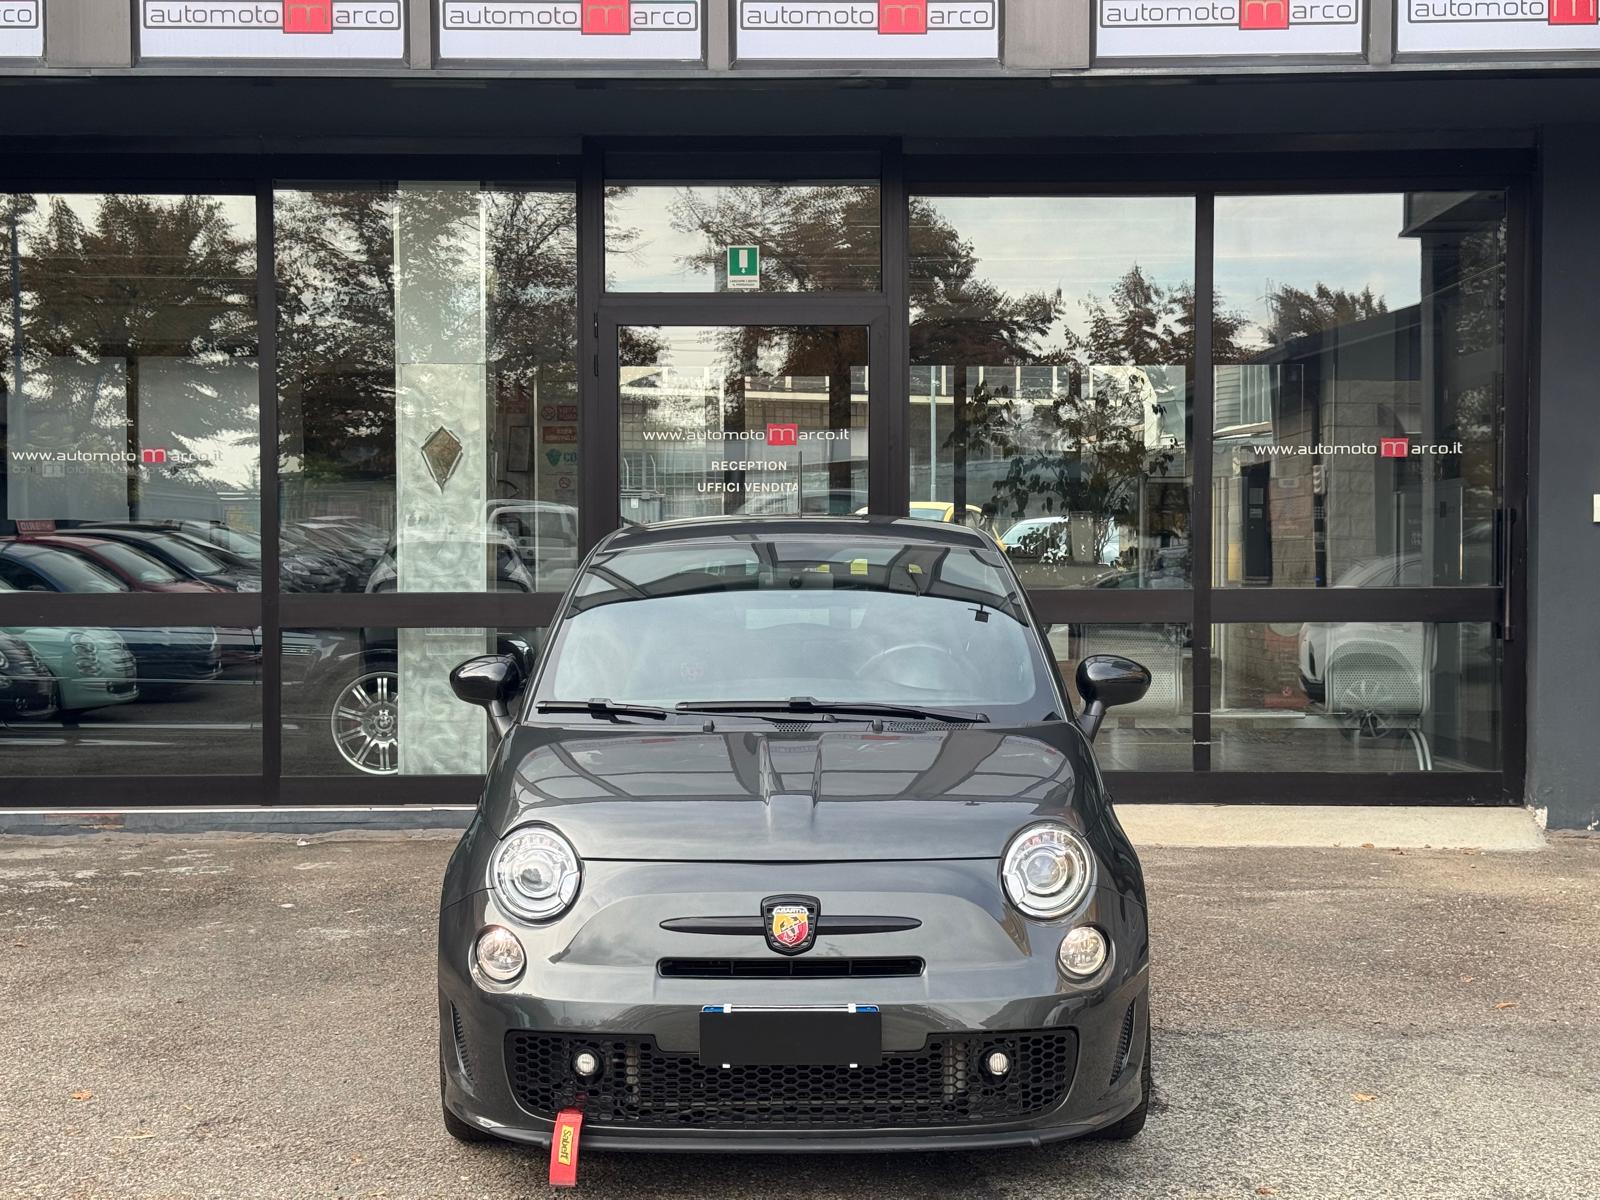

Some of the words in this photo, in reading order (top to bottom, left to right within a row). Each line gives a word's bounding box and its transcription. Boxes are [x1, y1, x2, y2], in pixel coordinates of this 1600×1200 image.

[642, 425, 850, 443] www.automotomarco.it
[1253, 440, 1463, 457] www.automotomarco.it
[711, 460, 787, 471] RECEPTION
[697, 482, 740, 493] UFFICI
[560, 1129, 572, 1161] Sabelt
